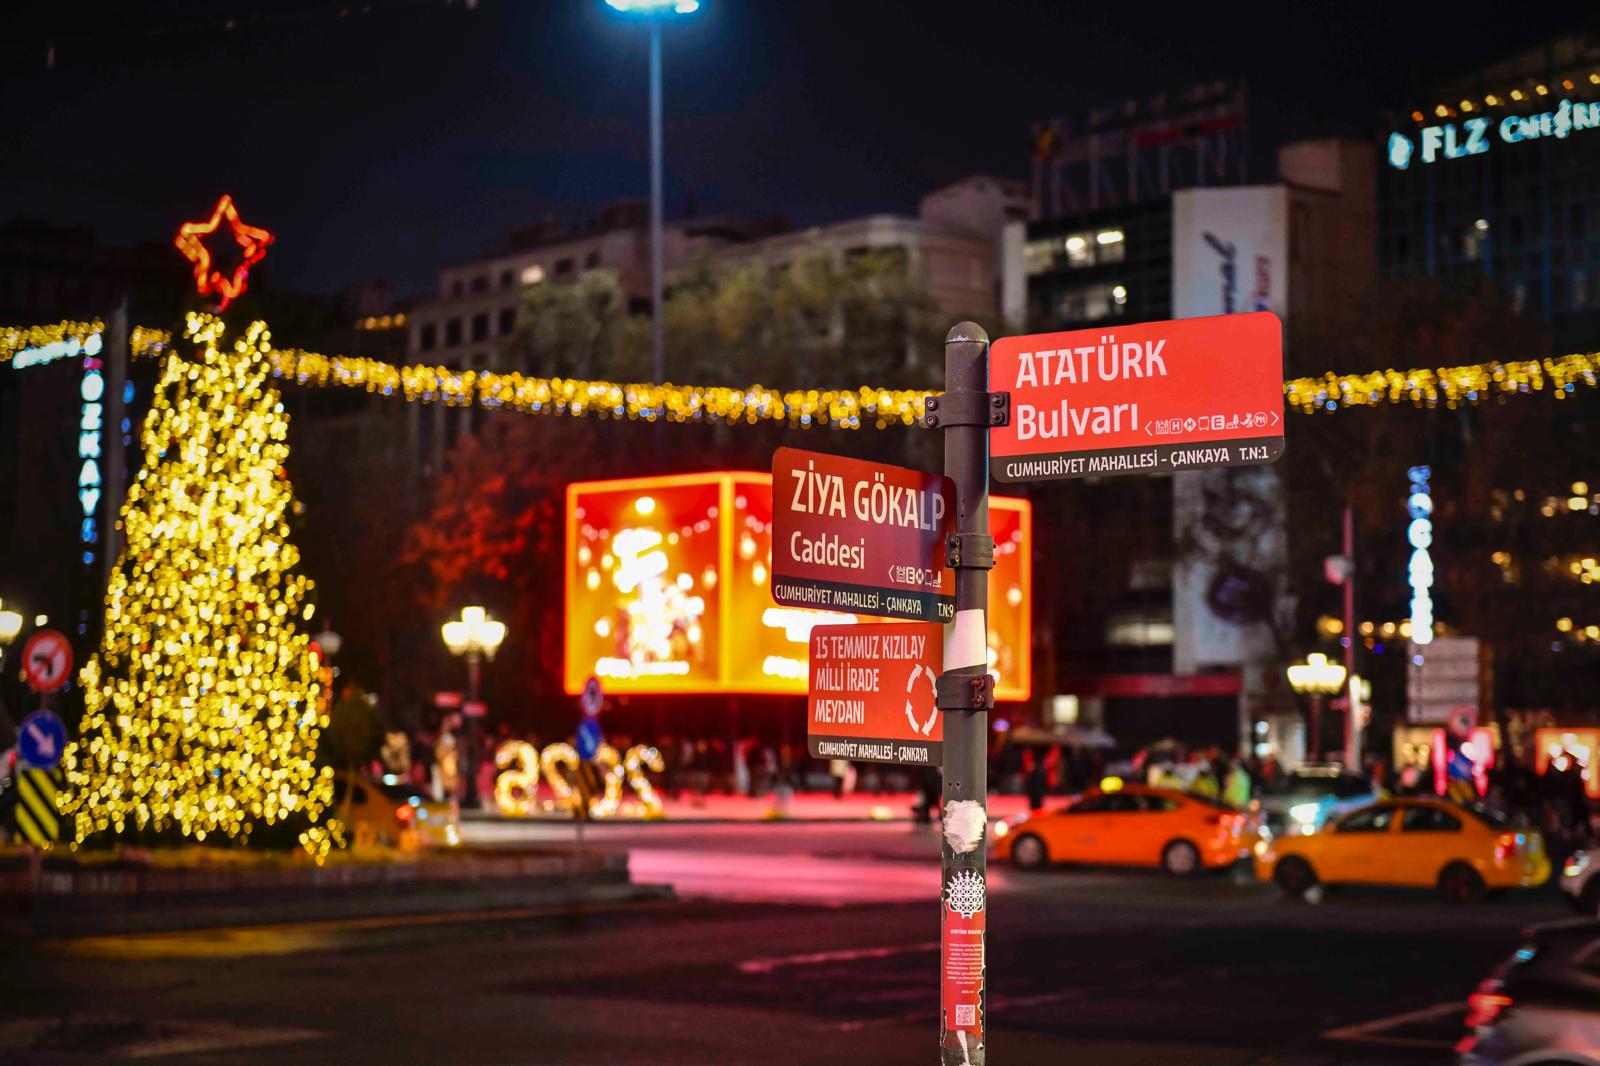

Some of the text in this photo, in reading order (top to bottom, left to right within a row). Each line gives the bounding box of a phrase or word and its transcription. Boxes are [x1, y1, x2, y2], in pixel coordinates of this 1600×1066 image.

[1420, 117, 1490, 163] FLZ
[1015, 335, 1167, 389] ATATÜRK
[1017, 400, 1138, 440] Bulvarı
[1006, 457, 1085, 478] CUMHURİYET
[1088, 449, 1158, 472] MAHALLESİ
[1170, 447, 1230, 467] ÇANKAYA
[1239, 445, 1270, 461] T.N:1
[791, 460, 945, 531] ZİYA GÖKALP
[790, 530, 865, 569] Caddesi
[775, 584, 831, 604] CUMHURİYET
[833, 591, 879, 609] MAHALLESİ
[886, 596, 922, 614] ÇANKAYA
[815, 635, 926, 660] 15 TEMMUZ KIZILAY
[815, 662, 844, 691] MİLLİ
[847, 662, 879, 692] İRADE
[815, 699, 865, 725] MEYDANI
[818, 740, 857, 758] CUMHURİYET
[858, 743, 893, 760] MAHALLESİ
[898, 746, 928, 762] ÇANKAYA
